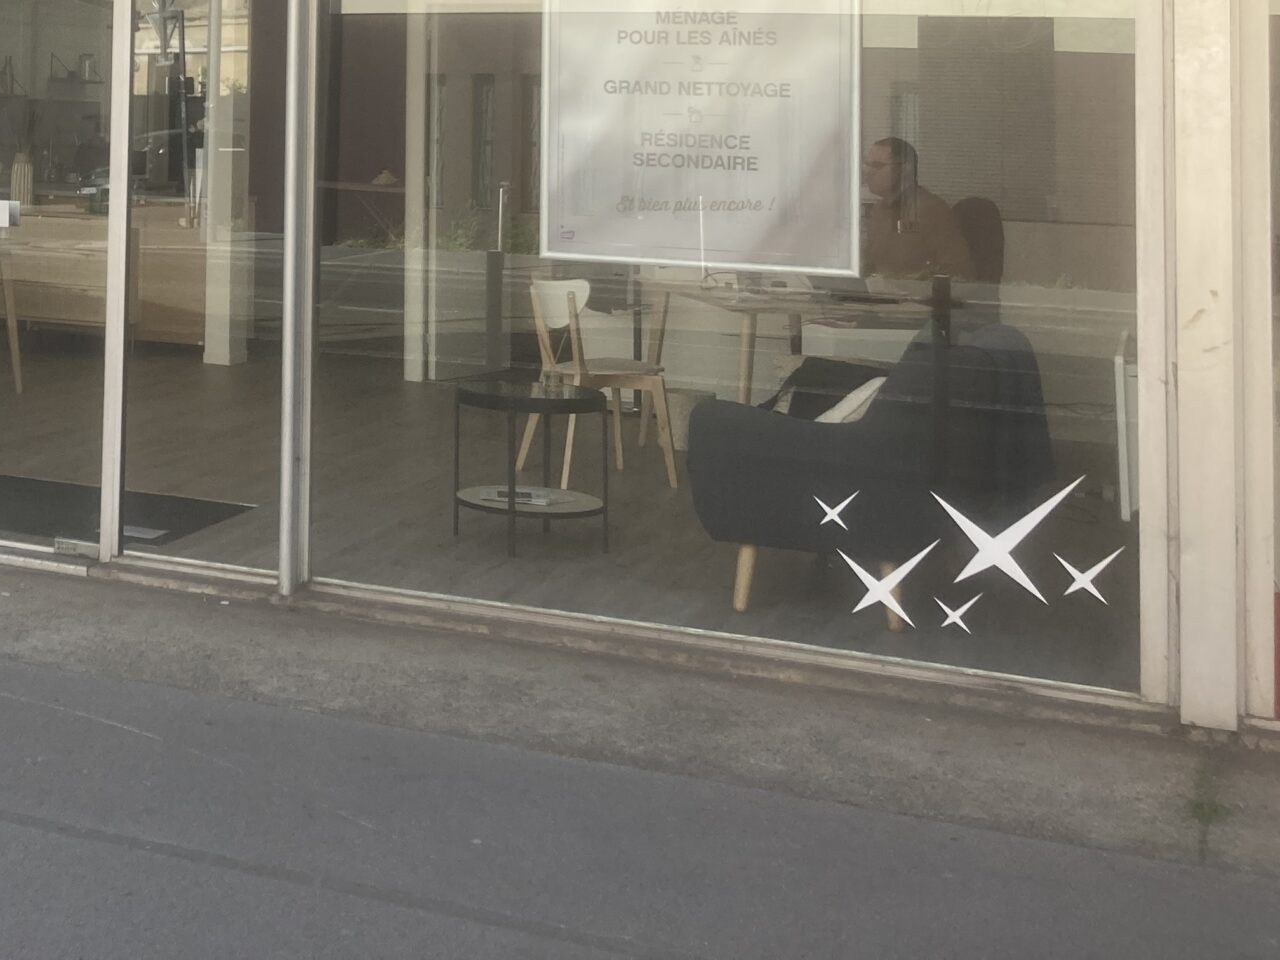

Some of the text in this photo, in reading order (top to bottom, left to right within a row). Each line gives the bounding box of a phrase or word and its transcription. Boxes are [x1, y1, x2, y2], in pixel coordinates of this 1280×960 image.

[655, 6, 739, 25] MÉNAGE
[617, 27, 778, 47] POUR LES AÎNÉS
[603, 79, 792, 99] GRAND NETTOYAGE
[640, 129, 751, 150] RÉSIDENCE
[632, 152, 759, 172] SECONDAIRE
[637, 197, 671, 212] bien
[709, 198, 765, 212] encore
